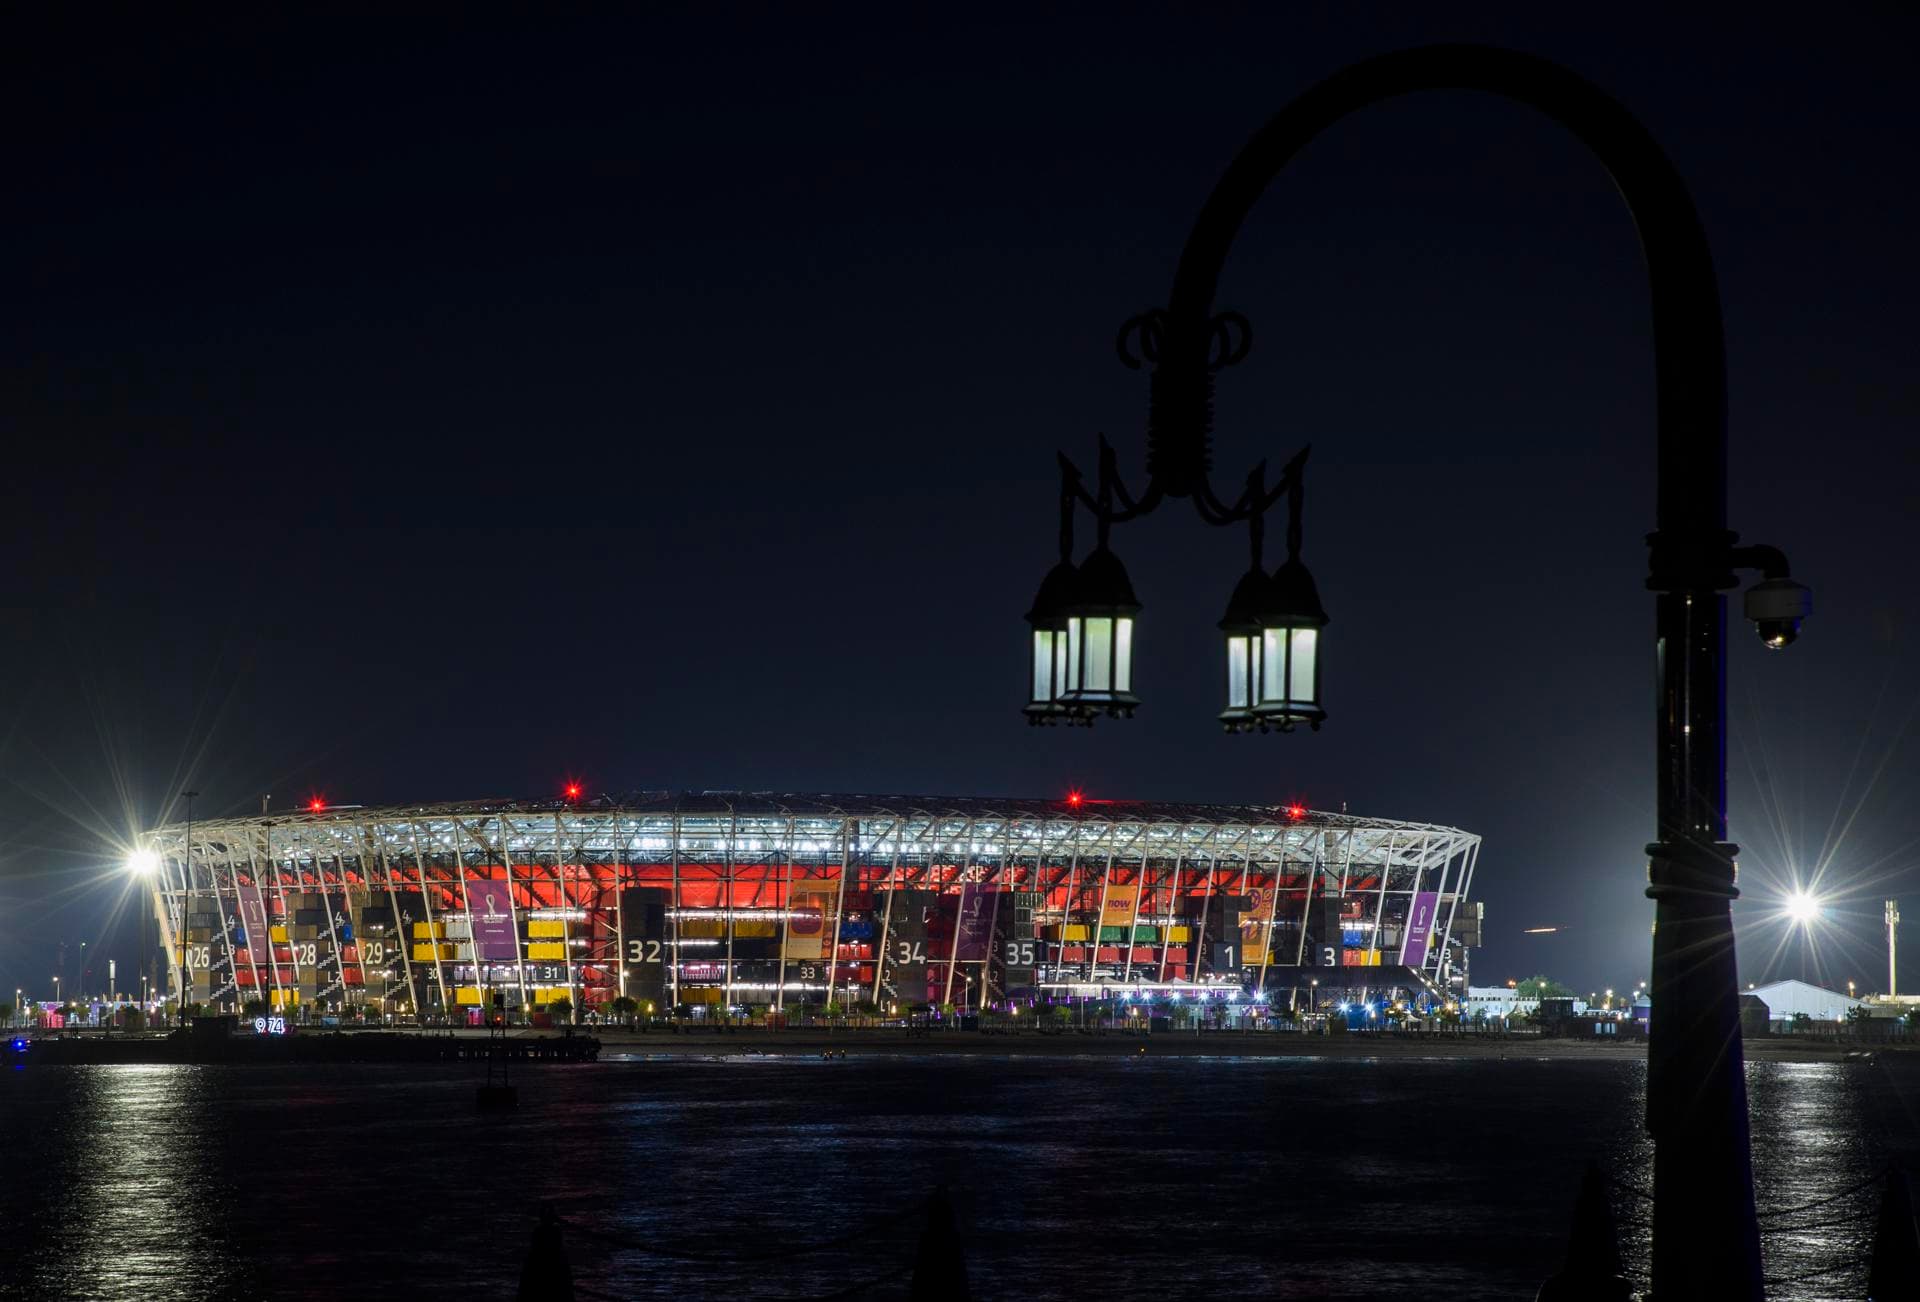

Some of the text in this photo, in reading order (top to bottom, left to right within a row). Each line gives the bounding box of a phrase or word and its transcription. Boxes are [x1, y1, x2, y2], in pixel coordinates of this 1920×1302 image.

[193, 946, 209, 968] 26
[300, 943, 316, 966] 28
[365, 942, 383, 965] 29
[628, 940, 661, 963] 32
[899, 941, 926, 965] 34
[1007, 943, 1034, 966] 35
[1224, 945, 1234, 968] 1
[1324, 947, 1336, 967] 3
[428, 967, 438, 980] 30
[544, 966, 558, 979] 31
[801, 966, 815, 979] 33
[220, 1001, 235, 1013] L1
[255, 1017, 286, 1035] 974
